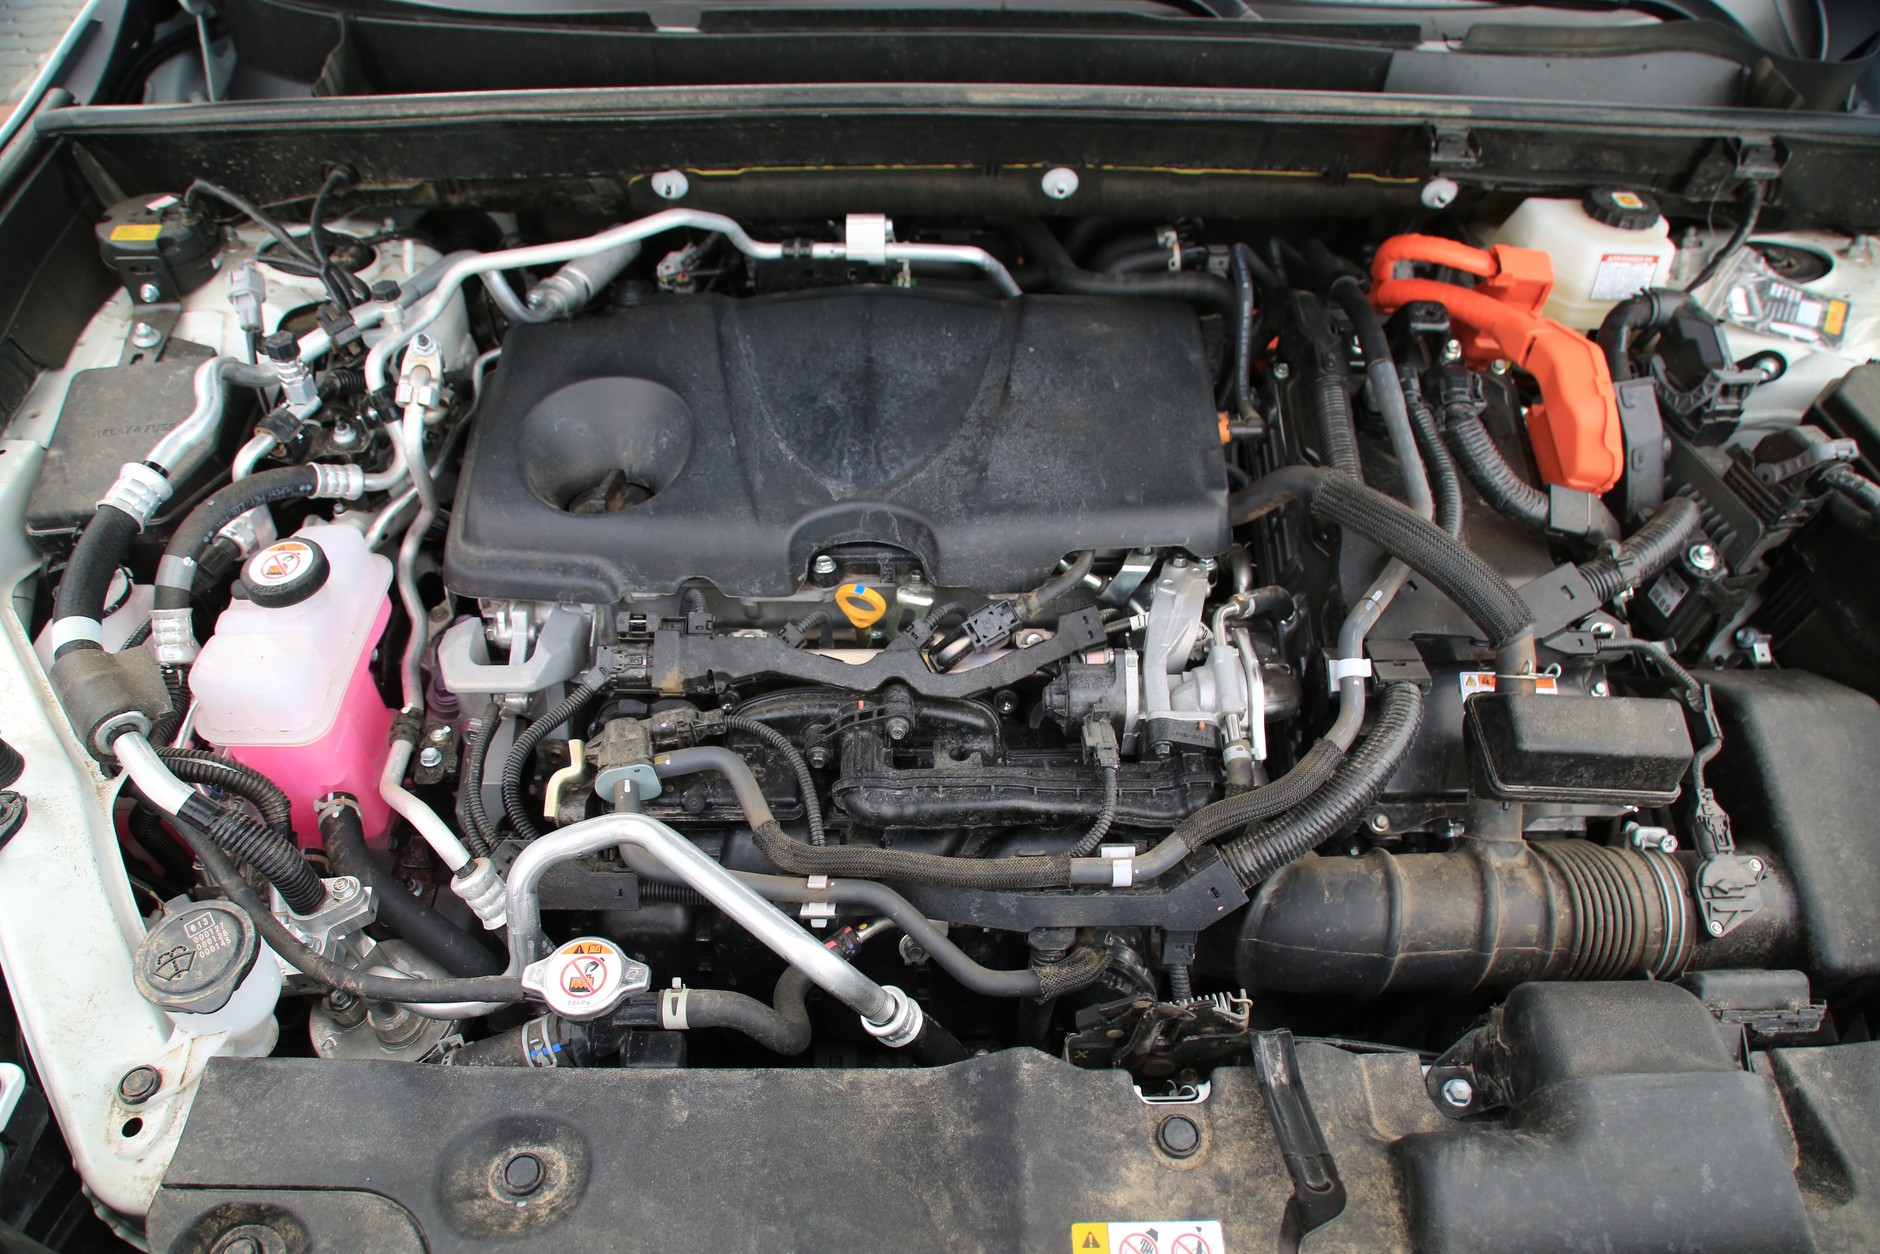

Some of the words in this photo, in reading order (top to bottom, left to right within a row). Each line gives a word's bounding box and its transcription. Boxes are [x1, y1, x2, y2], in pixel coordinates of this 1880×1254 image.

[193, 921, 224, 943] 000127
[196, 929, 229, 951] 000128
[199, 937, 232, 959] 000145
